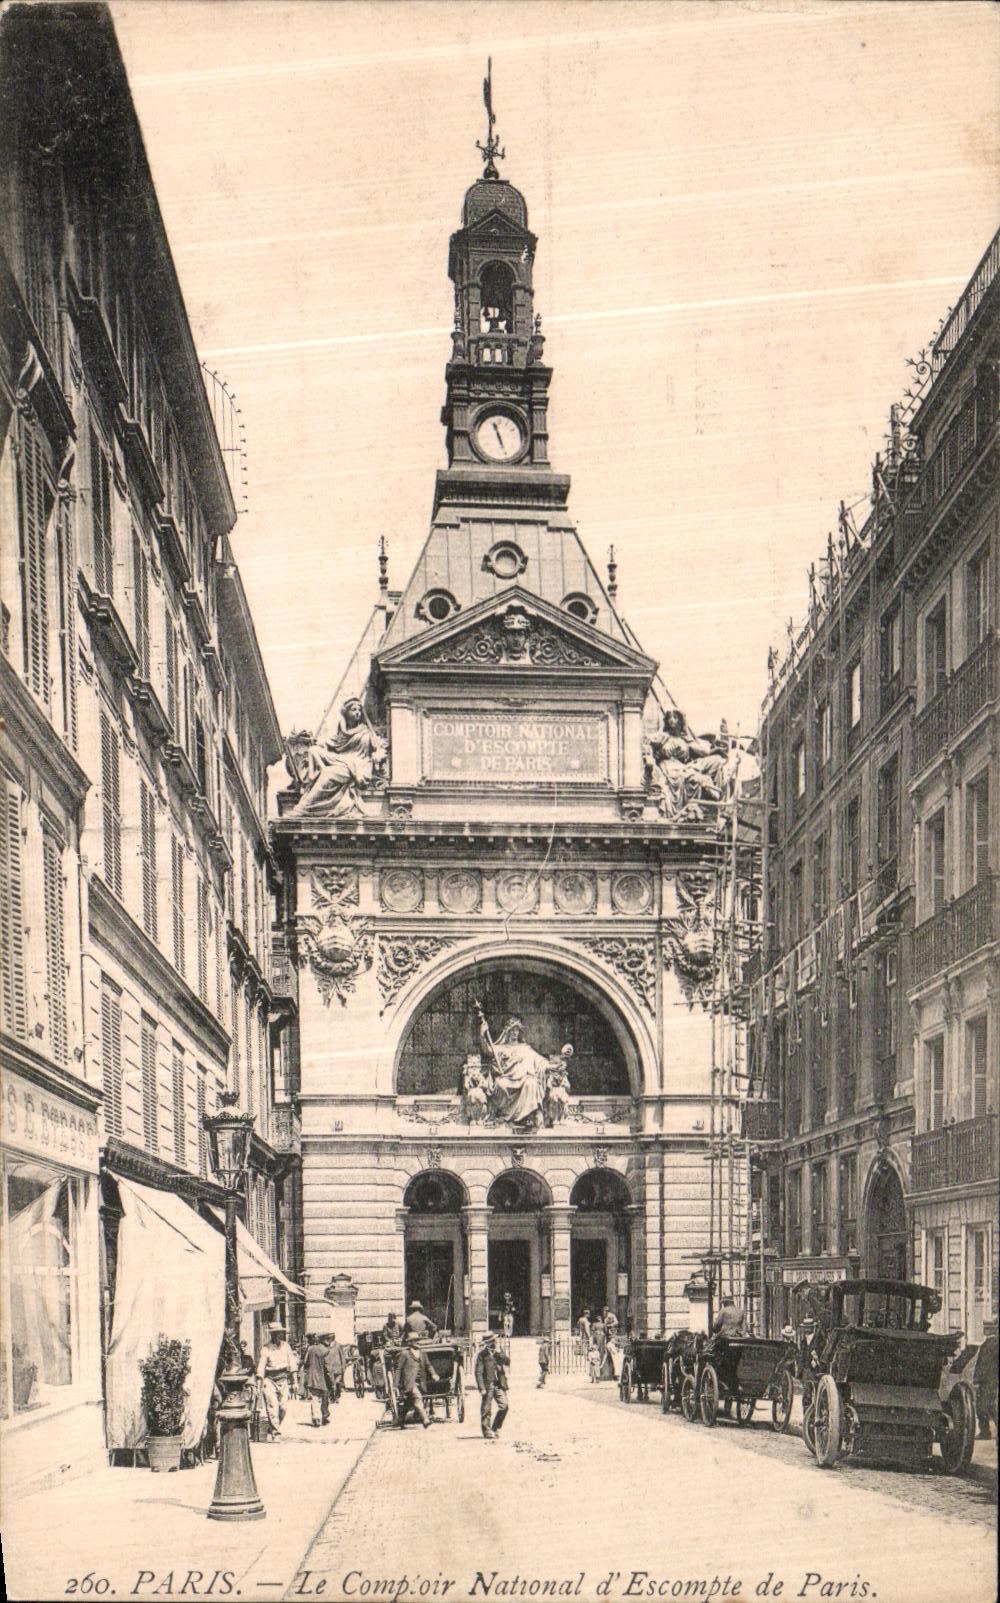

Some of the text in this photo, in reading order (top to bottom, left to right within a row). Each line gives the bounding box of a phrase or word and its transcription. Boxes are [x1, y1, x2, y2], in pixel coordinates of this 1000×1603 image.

[433, 723, 593, 739] COMPTOIR NATIONAL
[464, 740, 569, 755] D'ESCOMPTE
[481, 756, 552, 771] DE PARIS
